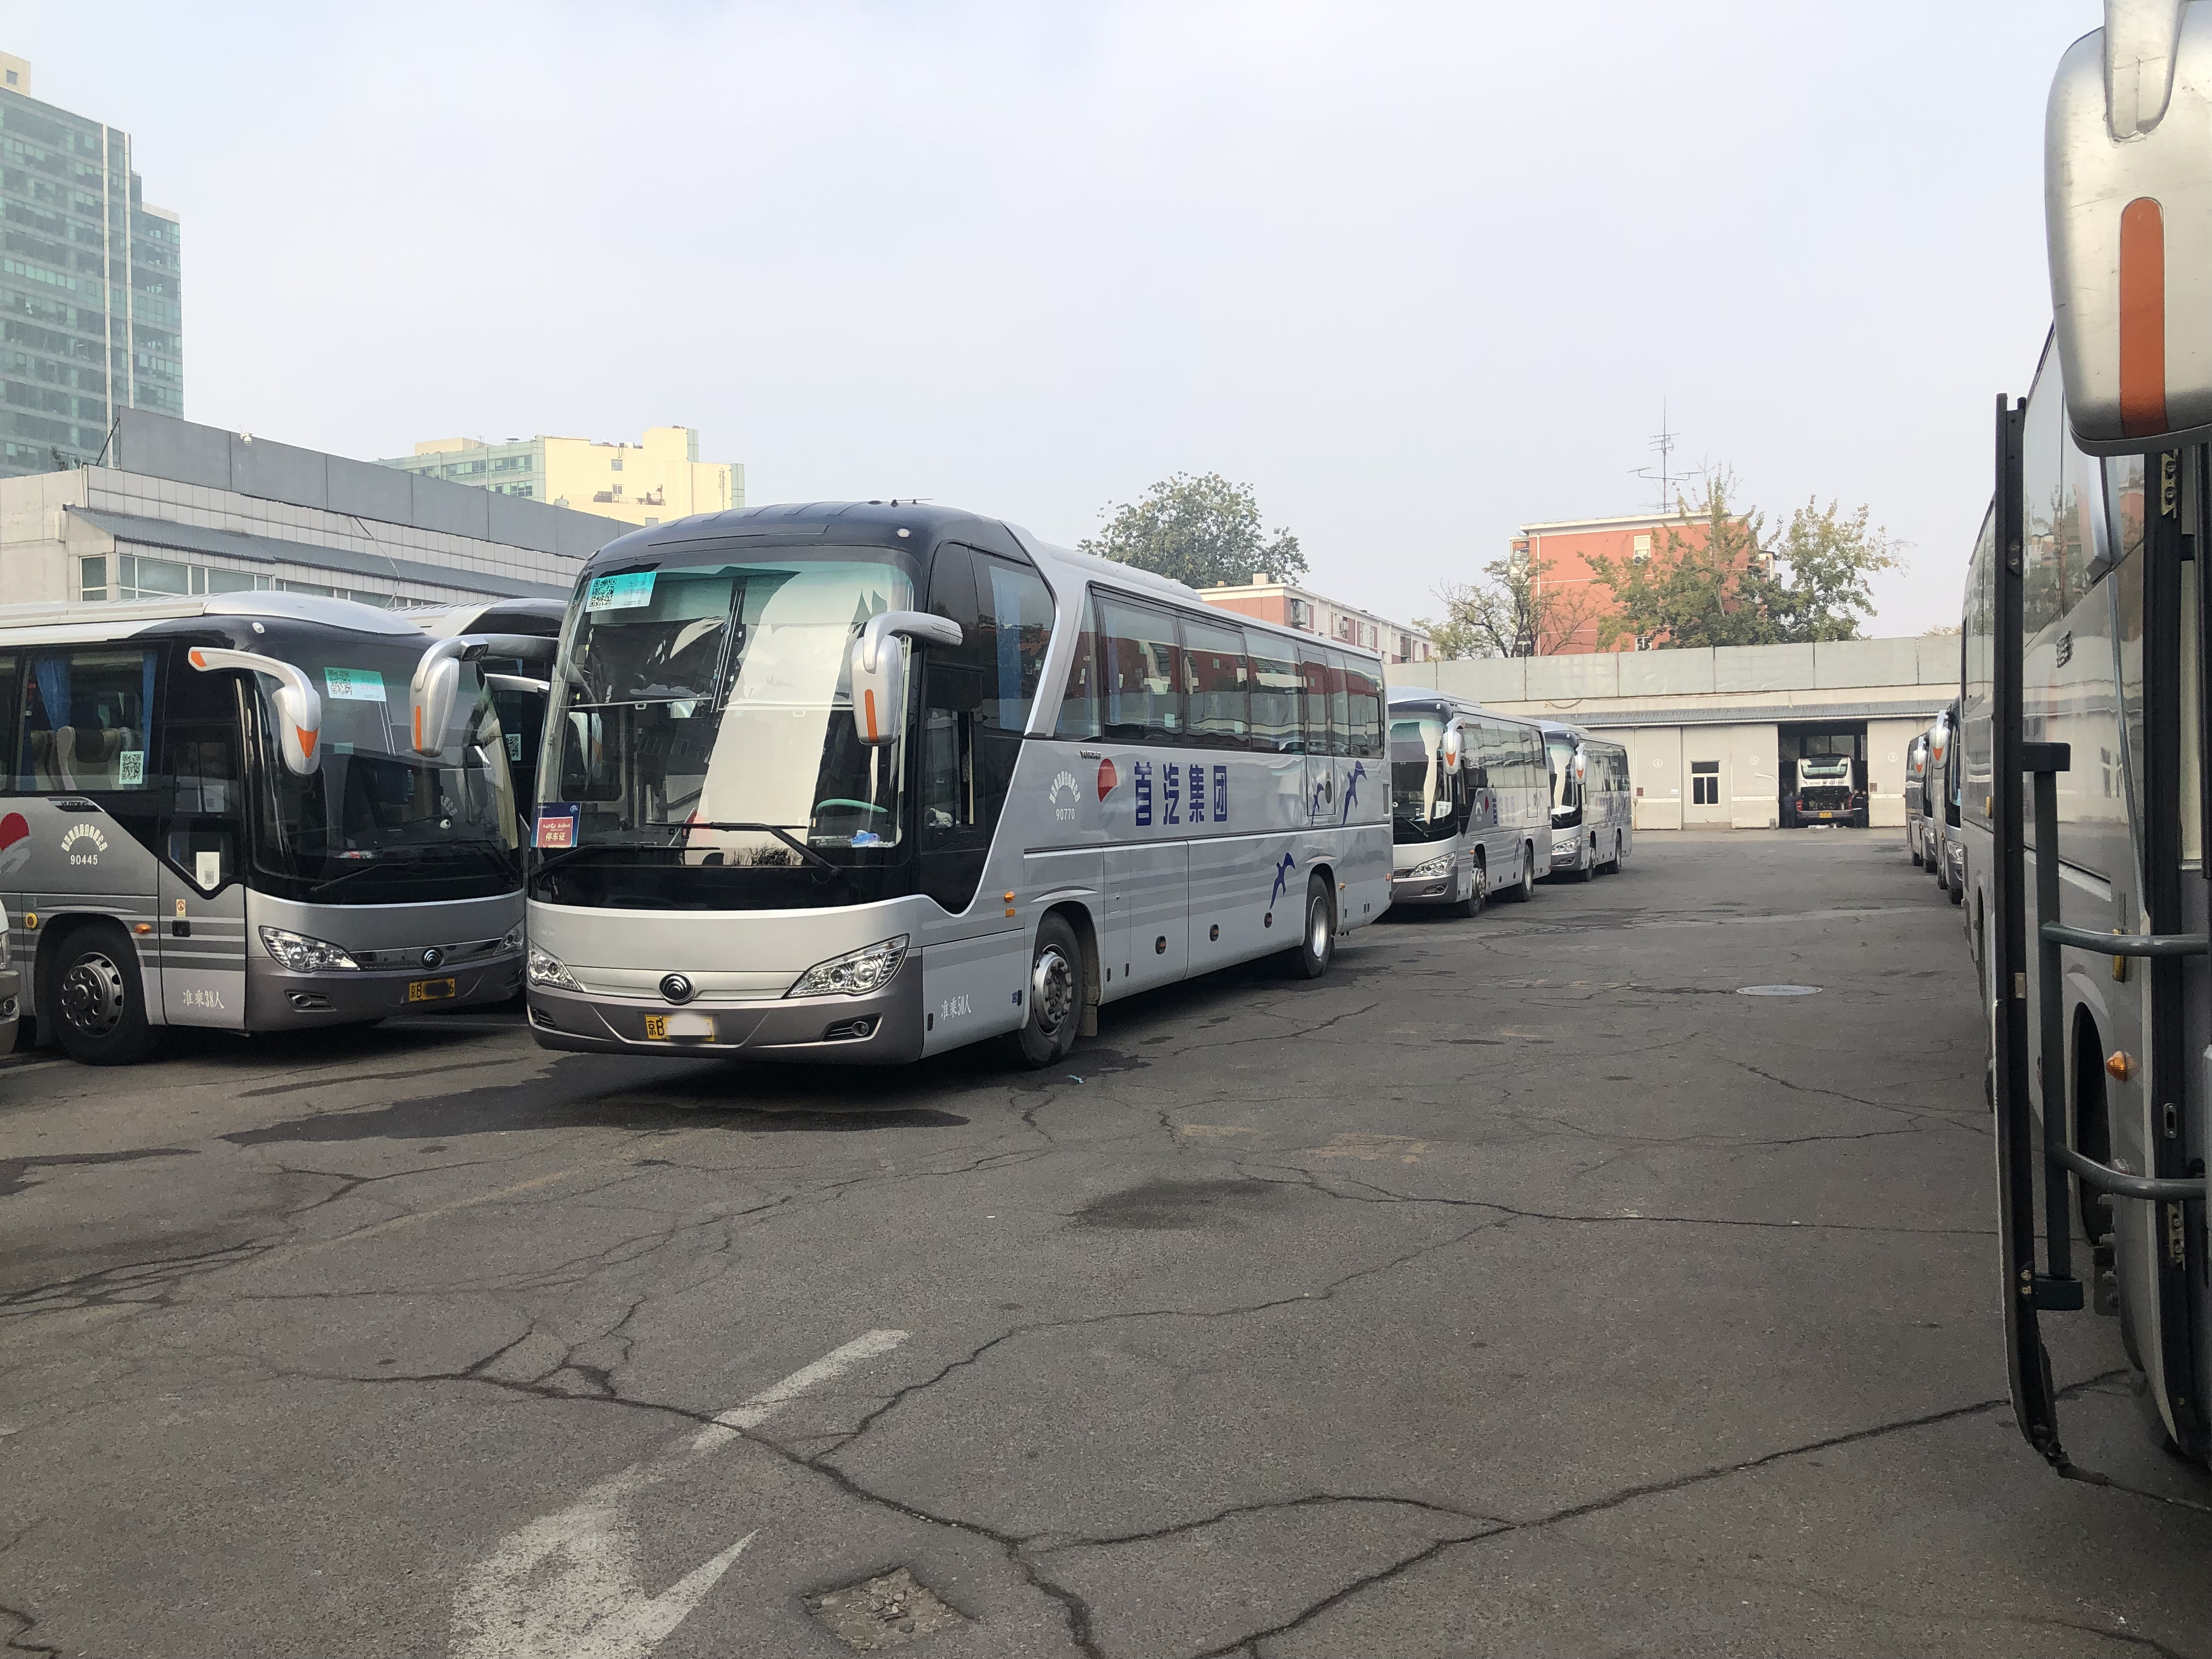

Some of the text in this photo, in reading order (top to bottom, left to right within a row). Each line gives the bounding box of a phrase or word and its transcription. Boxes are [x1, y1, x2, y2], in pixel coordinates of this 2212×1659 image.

[1135, 761, 1227, 827] 首汽集团
[1056, 808, 1075, 821] 90770
[545, 832, 566, 842] 停车证
[70, 854, 98, 865] 90445
[183, 989, 225, 1009] 准乘38人
[941, 994, 972, 1021] 准乘50人
